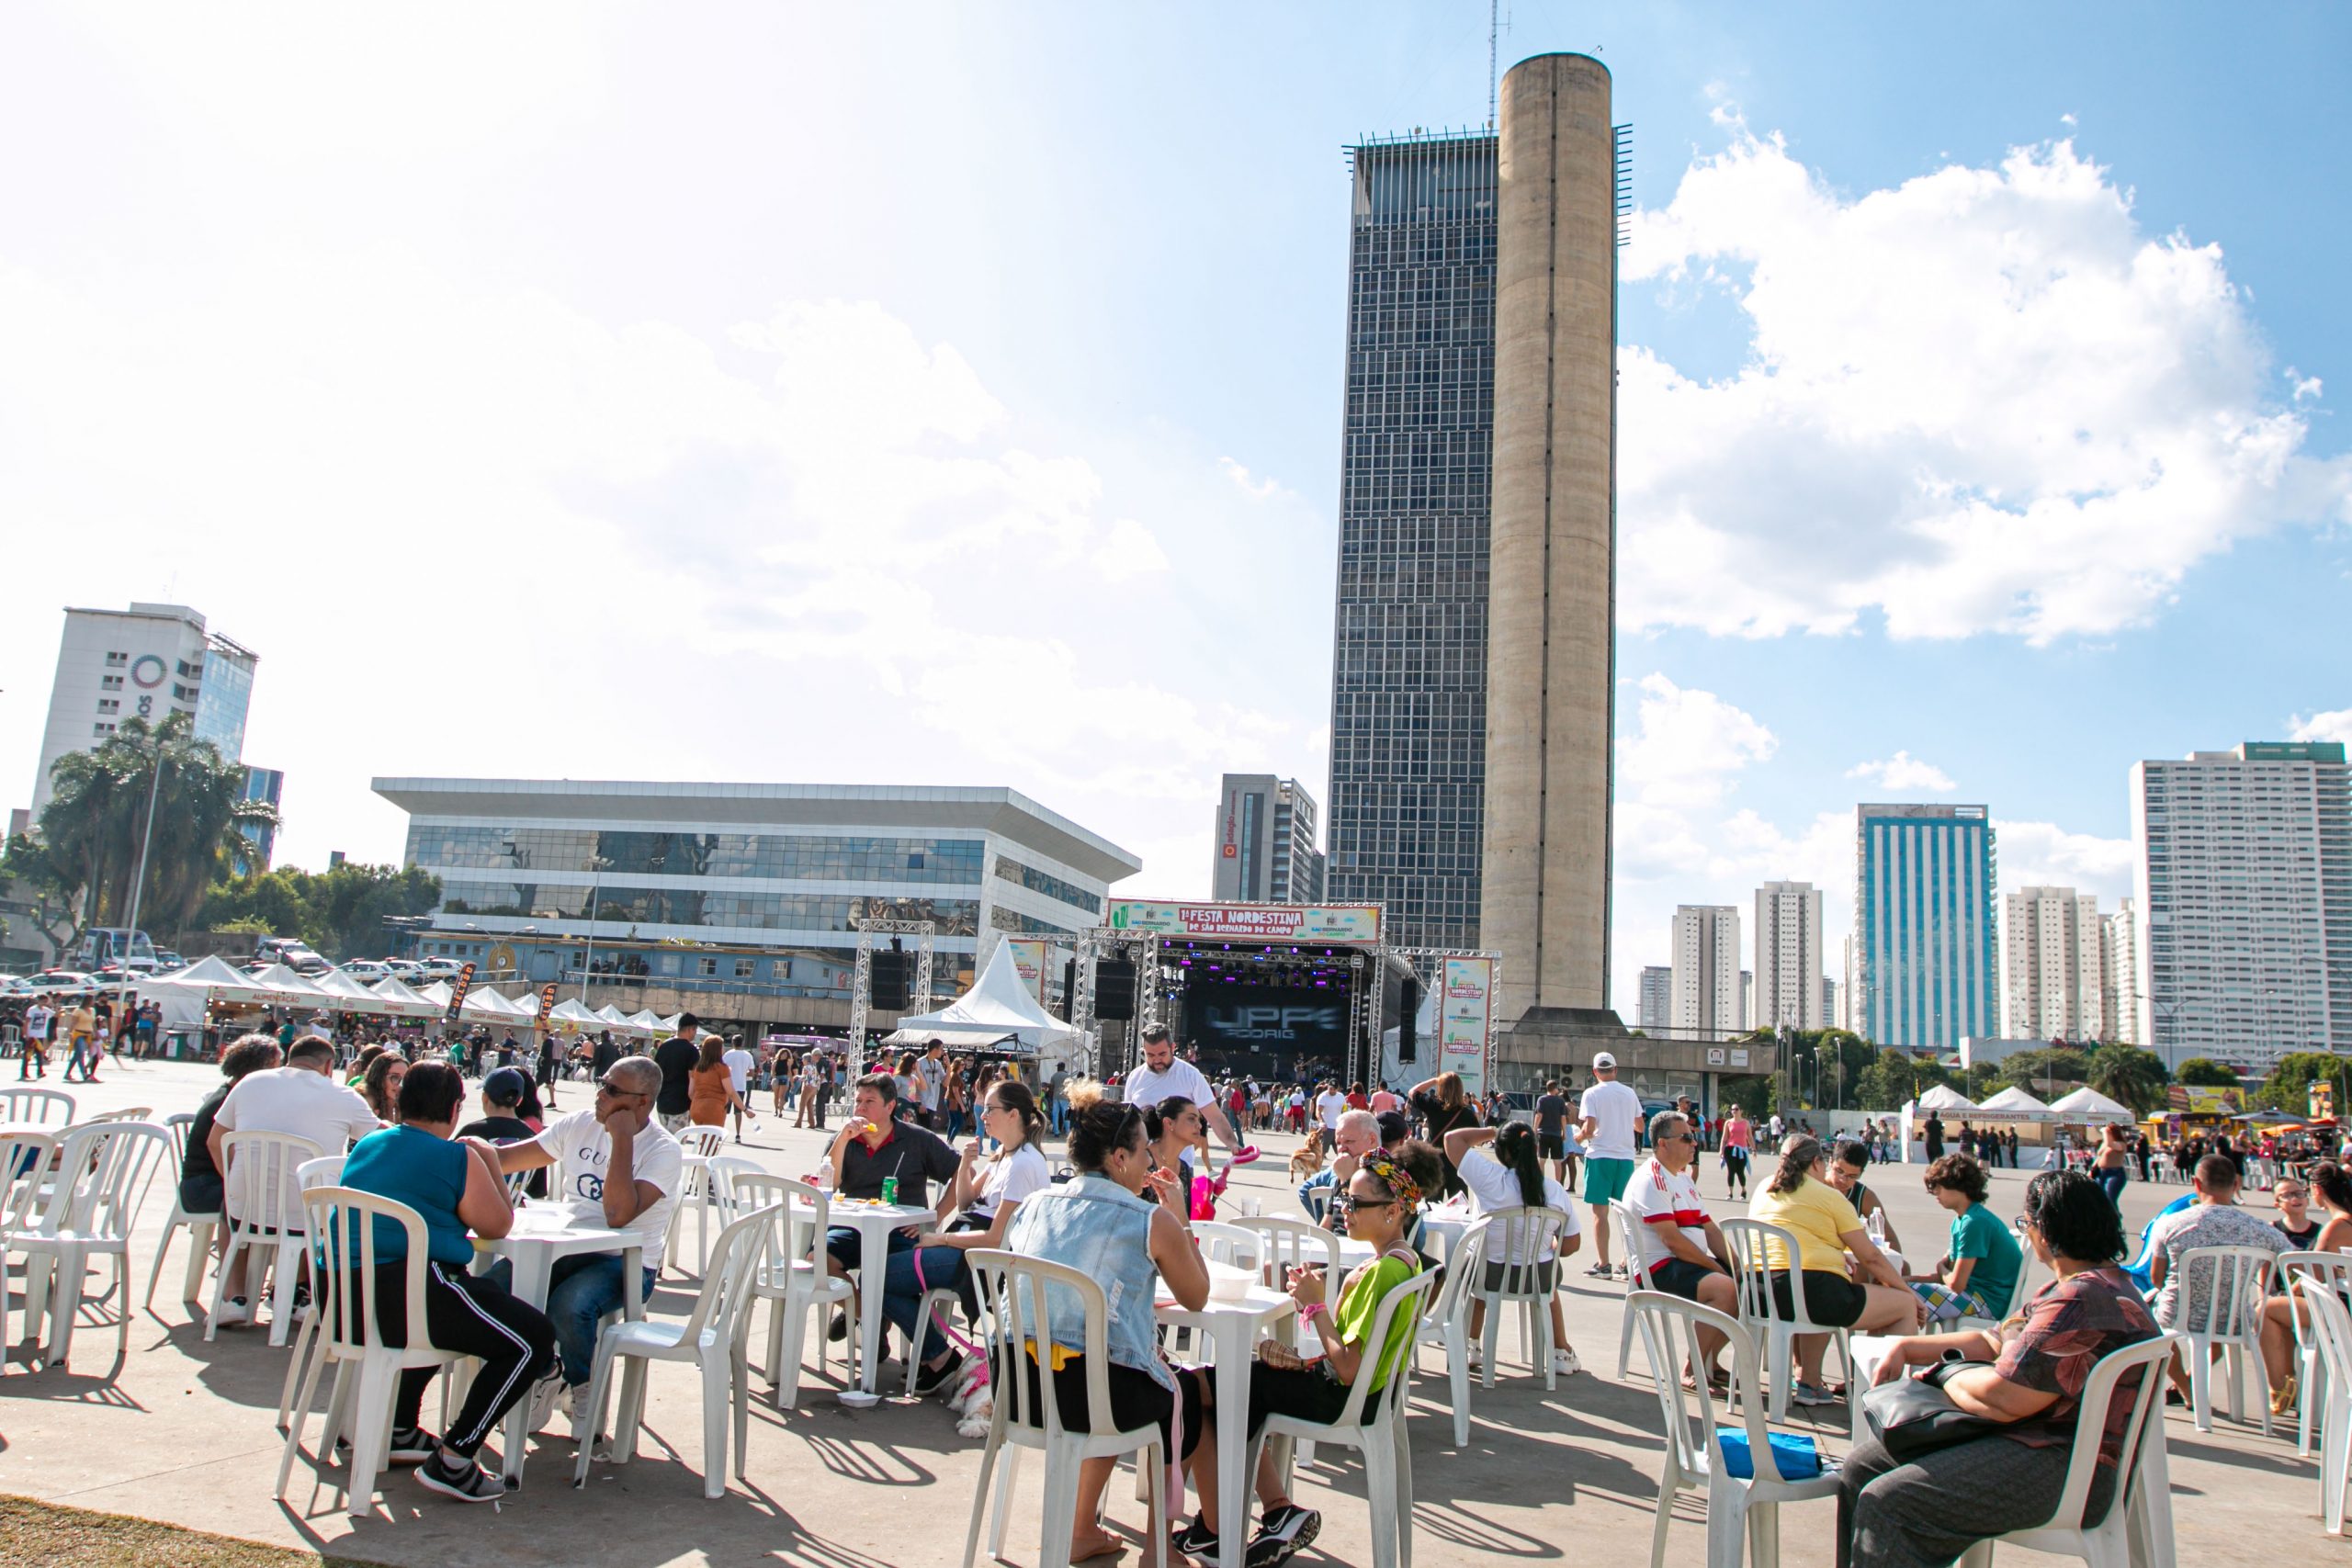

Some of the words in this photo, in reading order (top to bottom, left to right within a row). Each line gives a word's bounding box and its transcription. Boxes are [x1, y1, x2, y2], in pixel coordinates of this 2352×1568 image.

[1190, 910, 1223, 923] FESTA
[1227, 911, 1302, 925] NORDESTINA
[1254, 925, 1264, 933] DO
[1266, 926, 1292, 934] CAMPO
[251, 993, 301, 1004] ALIMENTAÇÃO
[469, 1011, 487, 1020] CHOPP
[487, 1014, 514, 1023] ARTESANAL
[1969, 1112, 2030, 1121] REFRIGERANTES
